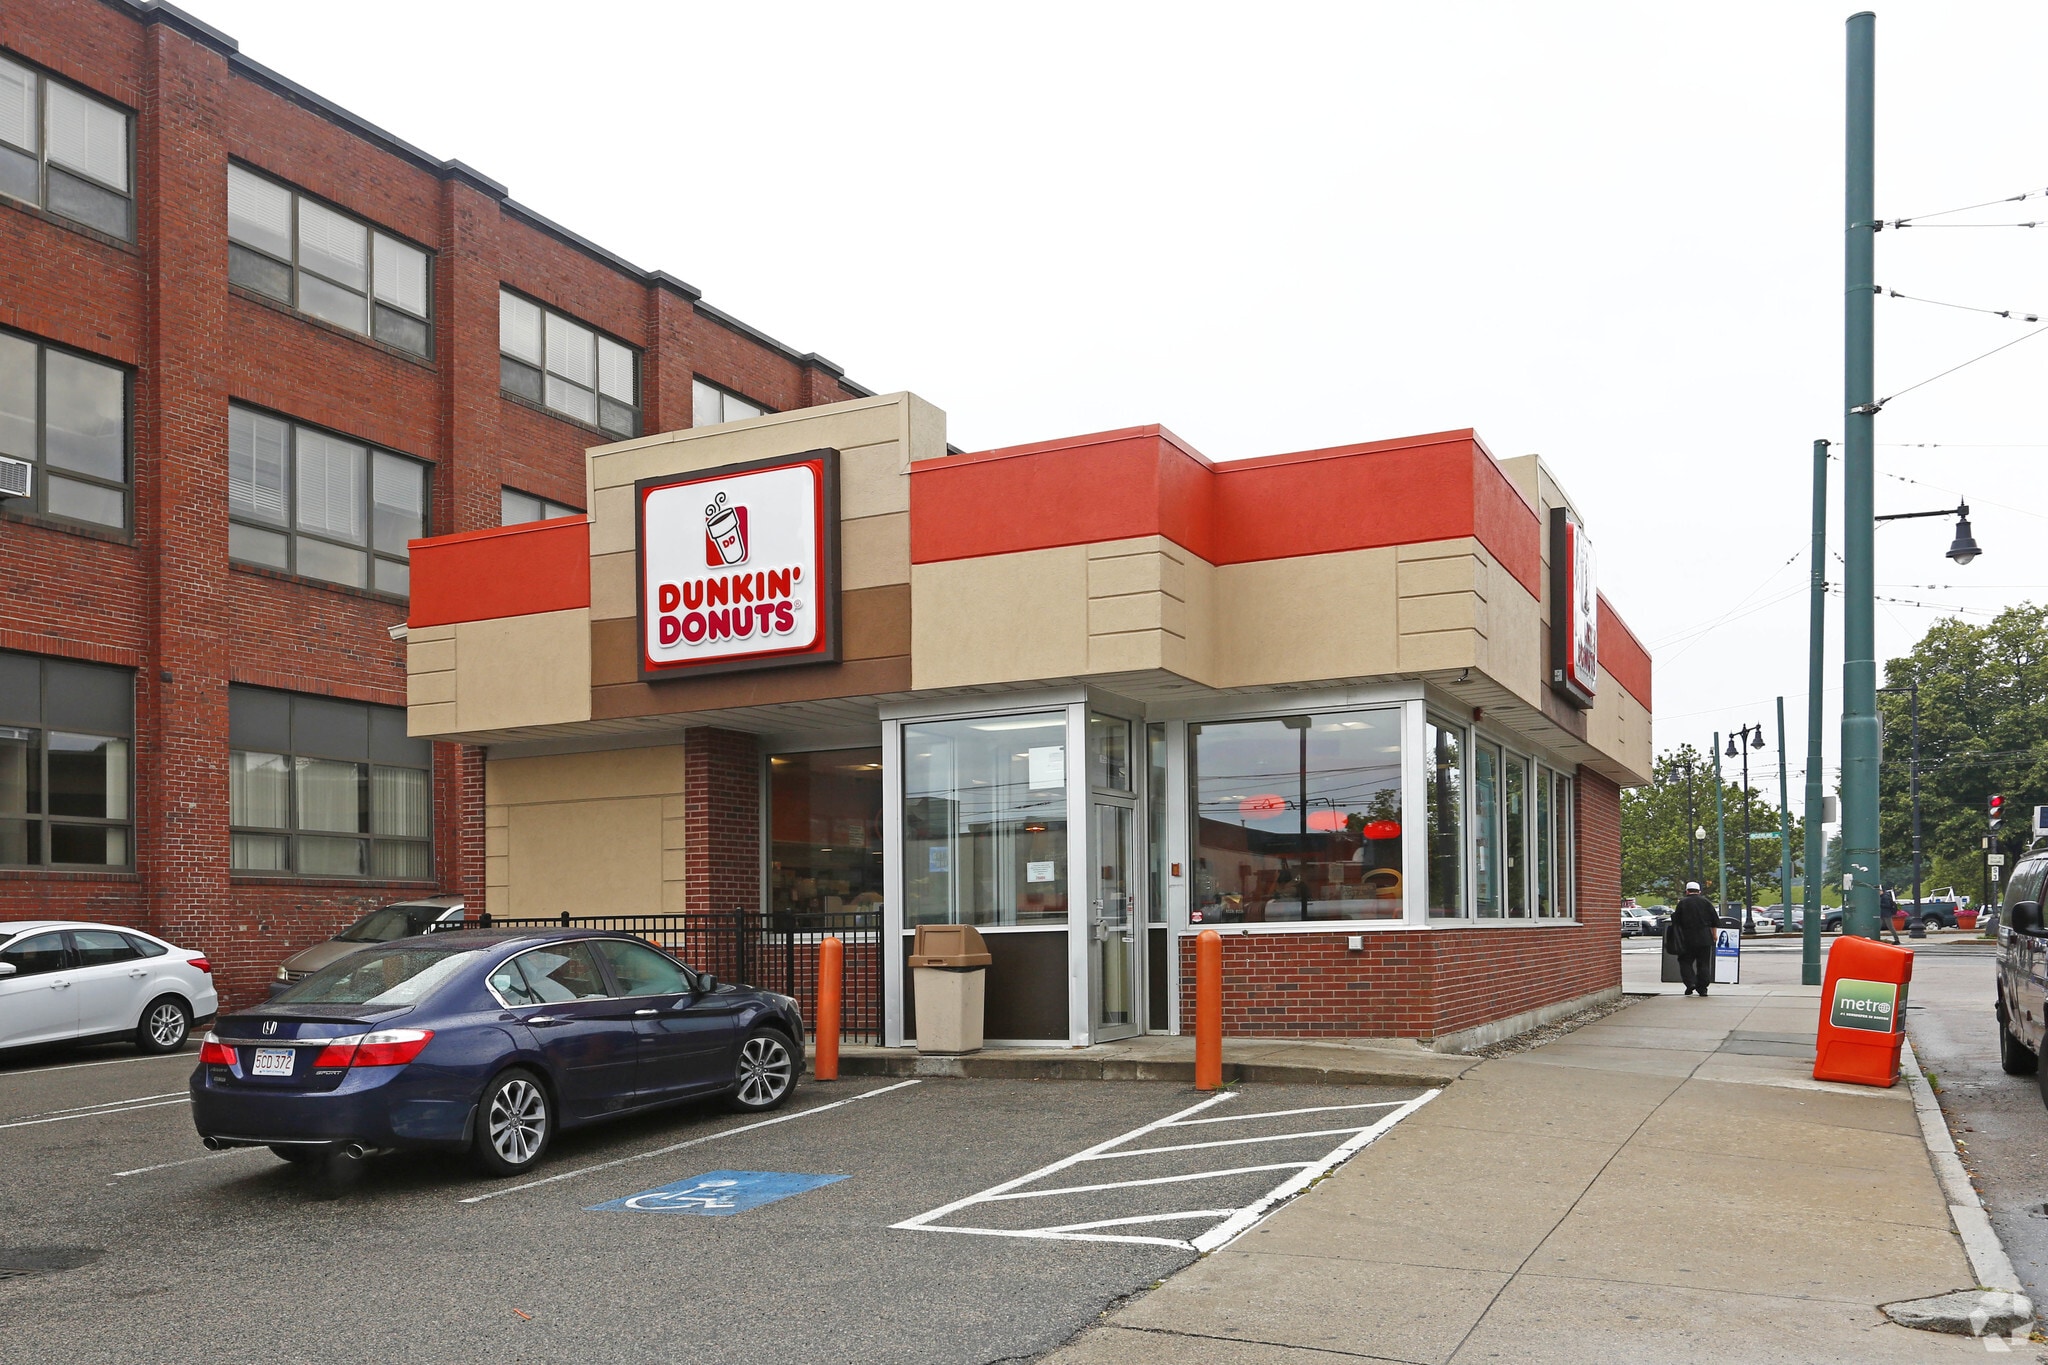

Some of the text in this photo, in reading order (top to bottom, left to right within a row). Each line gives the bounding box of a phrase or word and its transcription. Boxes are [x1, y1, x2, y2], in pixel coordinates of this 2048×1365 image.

[722, 535, 736, 548] DD
[658, 567, 802, 614] DUNKIN'
[659, 601, 795, 645] DONUTS
[1840, 998, 1891, 1014] metro
[274, 1055, 292, 1069] 372
